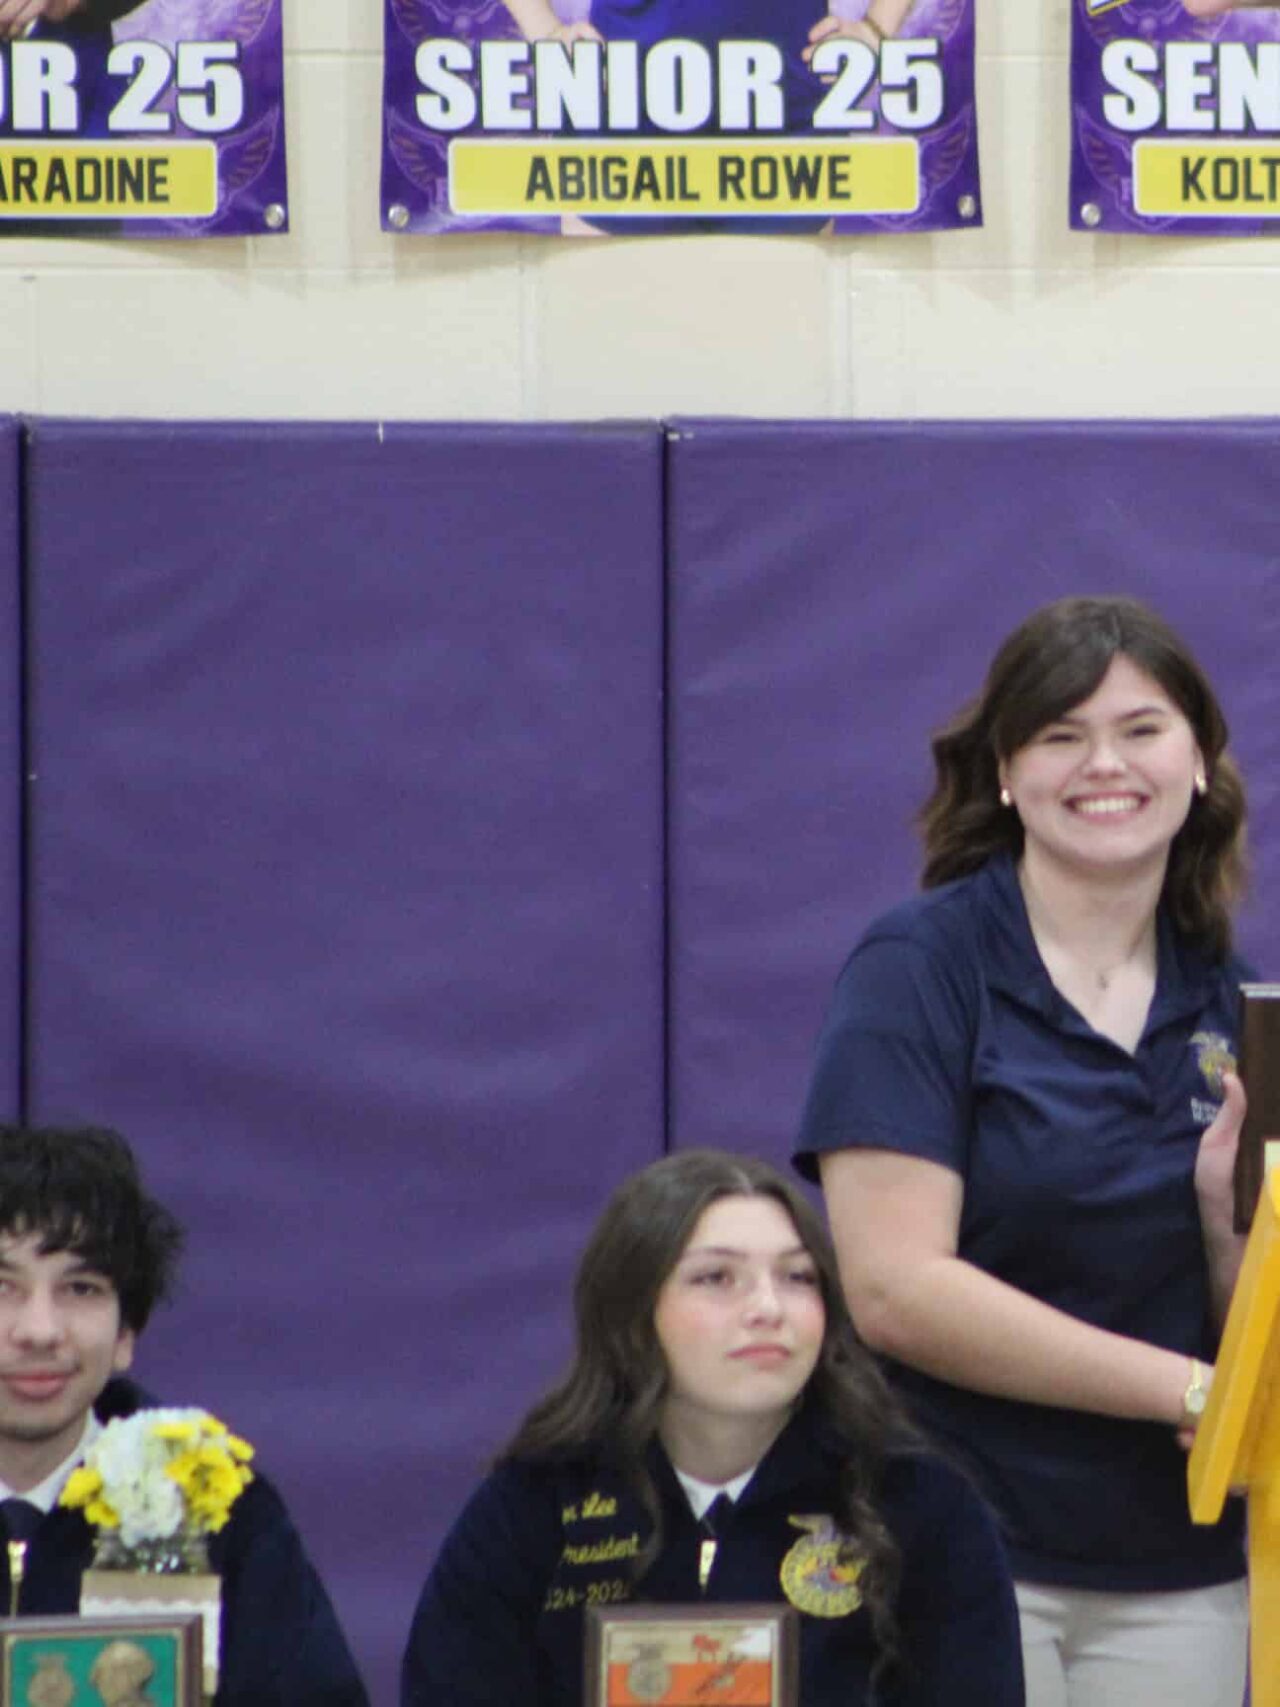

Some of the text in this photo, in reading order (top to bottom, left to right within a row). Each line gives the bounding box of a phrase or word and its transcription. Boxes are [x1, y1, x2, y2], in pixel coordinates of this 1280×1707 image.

[107, 40, 244, 133] 25
[415, 37, 944, 133] SENIOR 25
[526, 156, 852, 202] ABIGAIL ROWE
